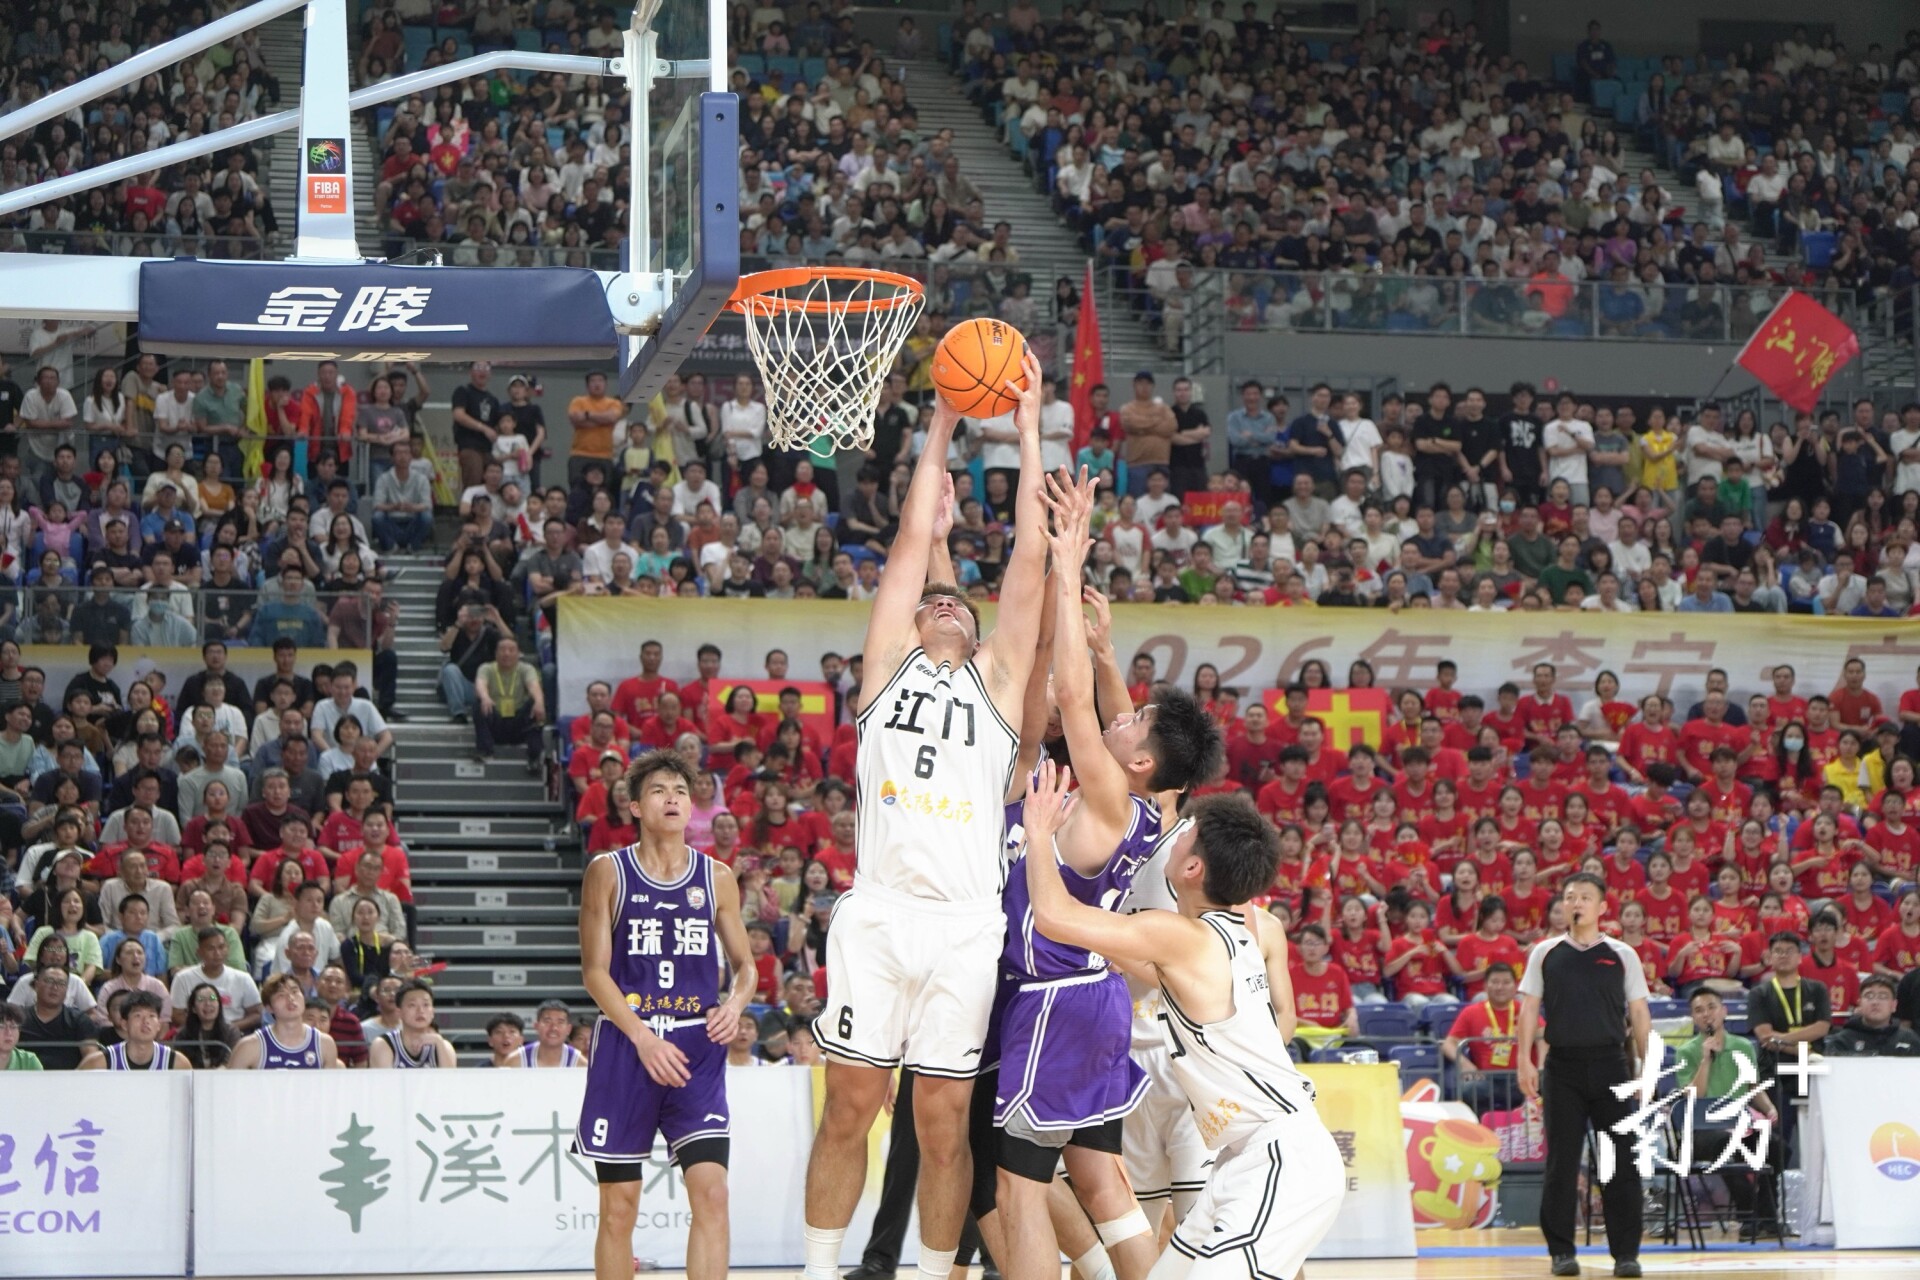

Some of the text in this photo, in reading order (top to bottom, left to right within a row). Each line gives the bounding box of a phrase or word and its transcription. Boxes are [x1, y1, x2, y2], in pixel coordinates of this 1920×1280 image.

[314, 182, 340, 194] FIBA
[216, 286, 469, 332] 金陵
[884, 688, 976, 747] 江门
[914, 744, 938, 780] 6
[627, 917, 709, 956] 珠海
[658, 960, 675, 989] 9
[838, 1004, 854, 1041] 6
[591, 1117, 609, 1147] 9
